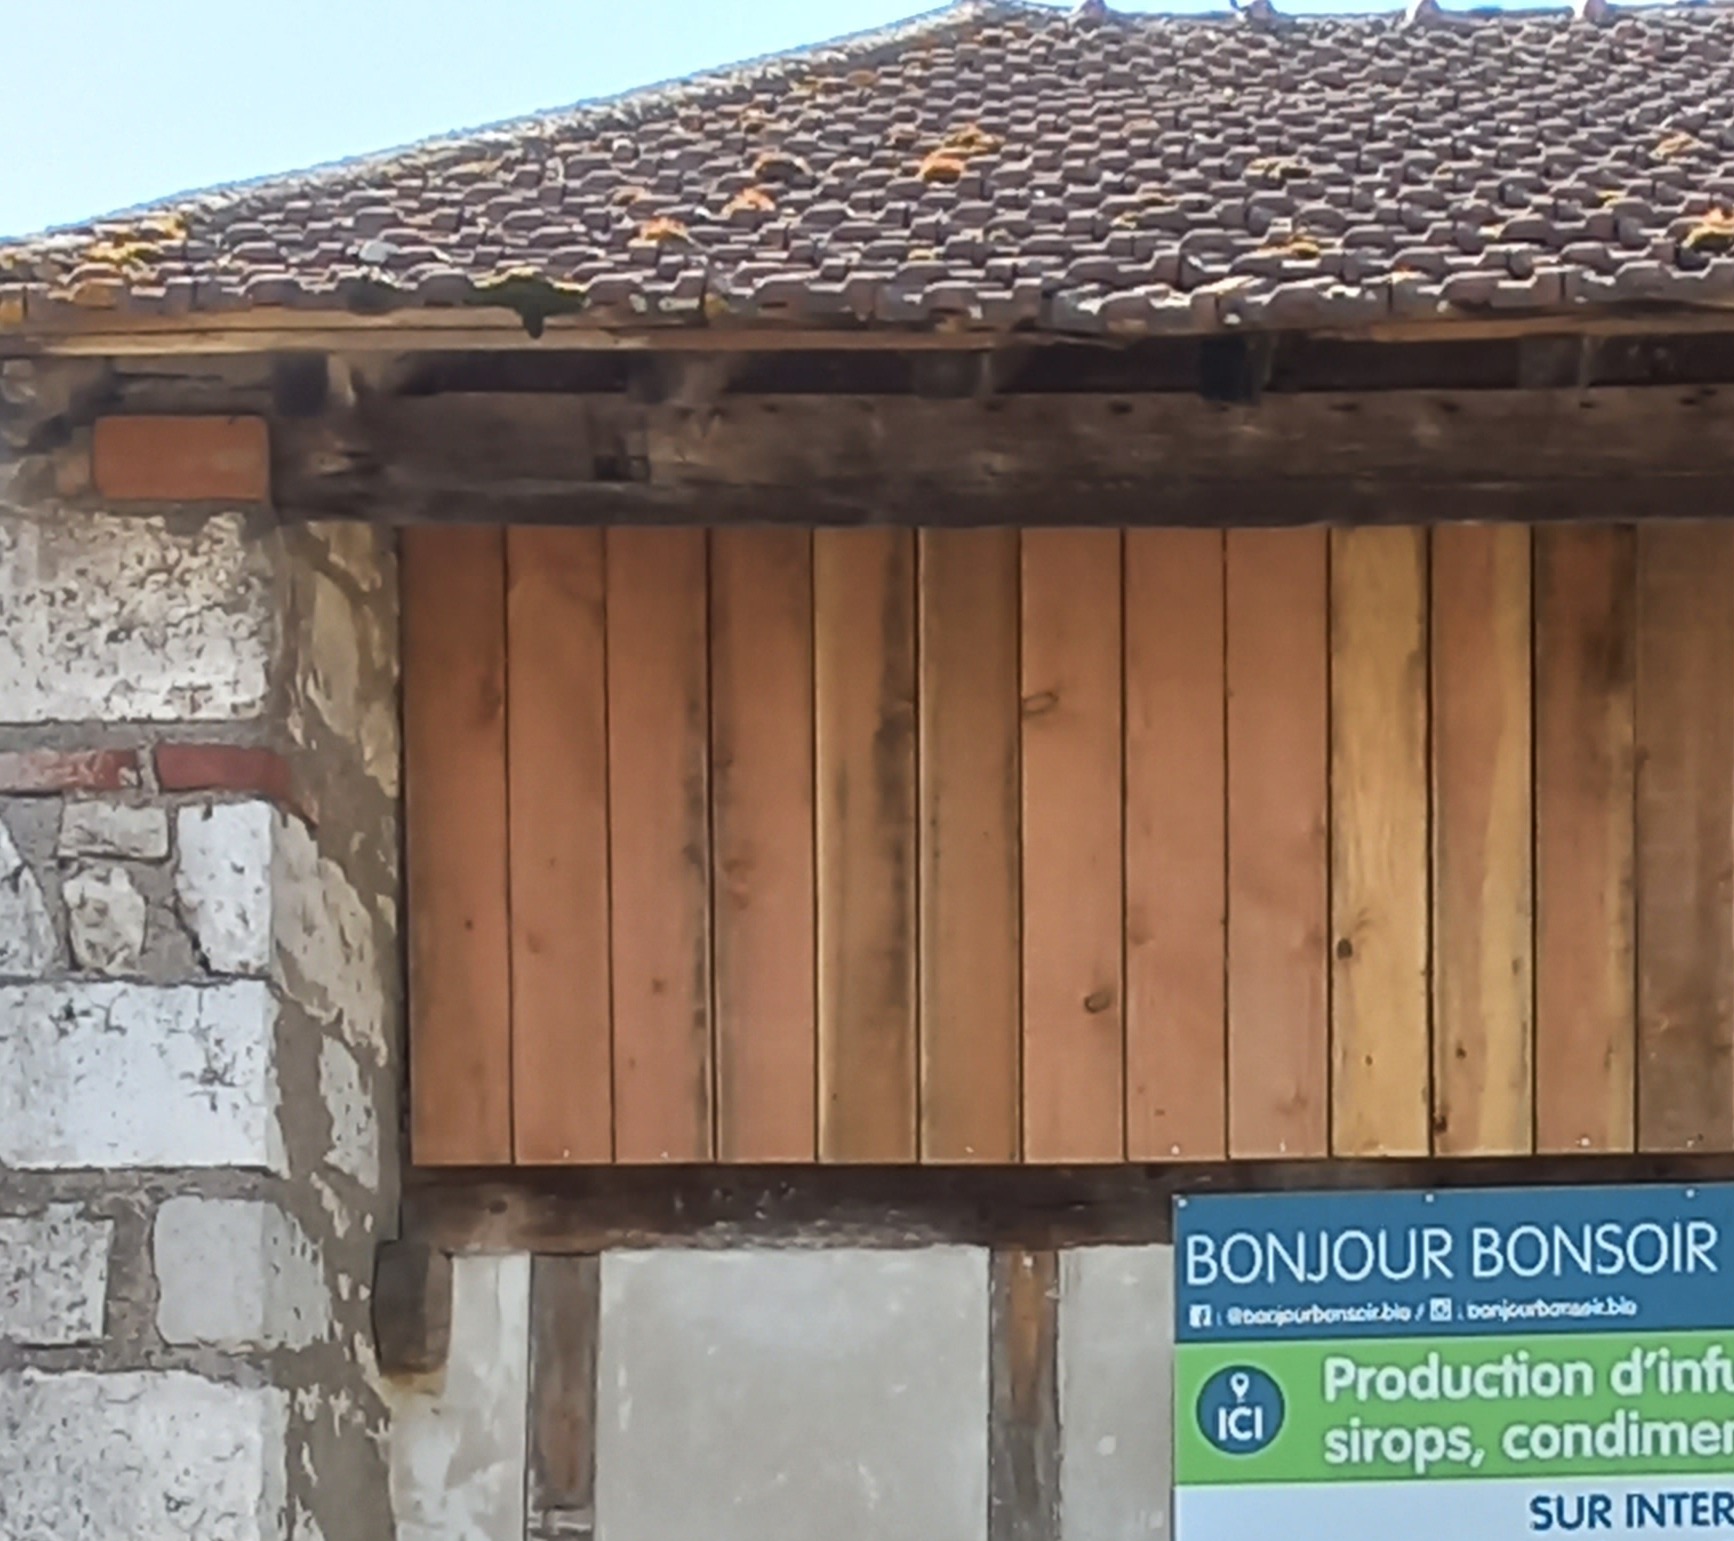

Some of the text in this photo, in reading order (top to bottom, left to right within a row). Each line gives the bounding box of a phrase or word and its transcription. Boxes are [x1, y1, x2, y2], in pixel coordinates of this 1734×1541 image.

[1185, 1221, 1719, 1286] BONJOUR BONSOIR
[1323, 1351, 1594, 1402] Production
[1217, 1407, 1264, 1443] ICI
[1323, 1417, 1484, 1474] sirops,
[1529, 1494, 1613, 1531] SUR
